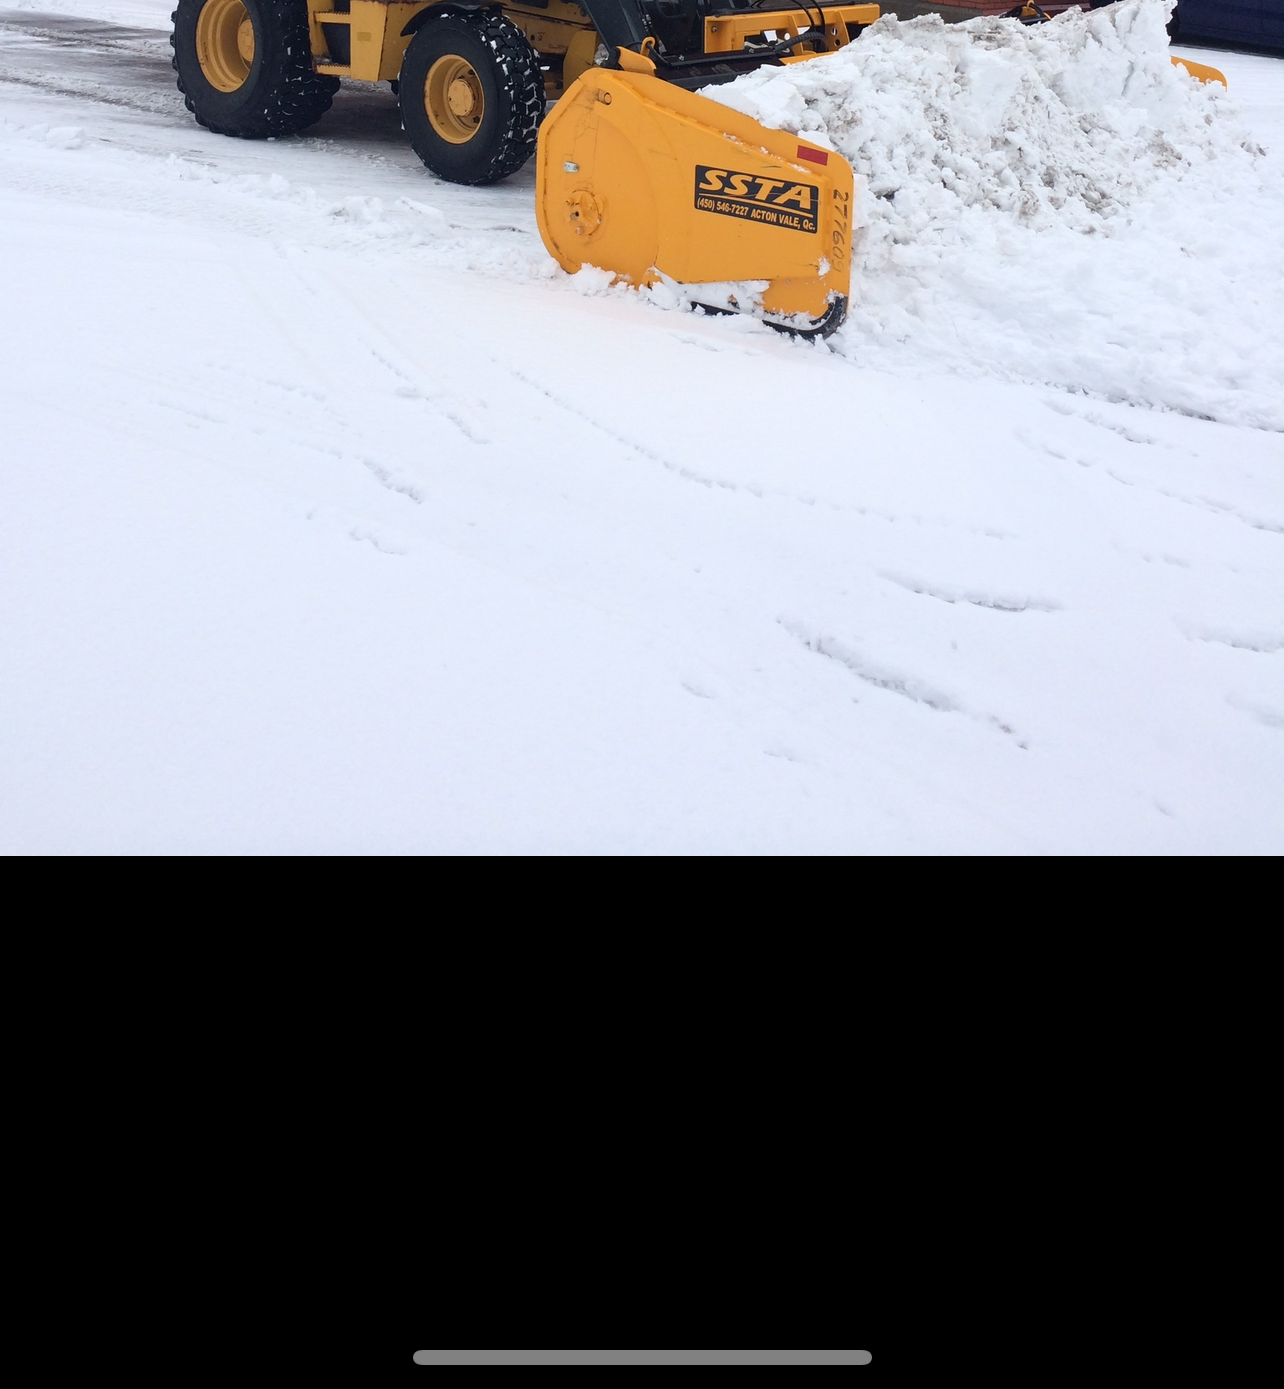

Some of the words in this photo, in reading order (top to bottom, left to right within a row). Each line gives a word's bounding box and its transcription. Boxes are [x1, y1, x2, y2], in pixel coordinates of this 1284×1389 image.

[698, 169, 811, 210] SSTA
[697, 197, 715, 212] (450)
[716, 200, 749, 216] 546-7227
[750, 208, 778, 224] ACTON
[778, 213, 801, 230] VALE,
[802, 219, 816, 231] Qc.
